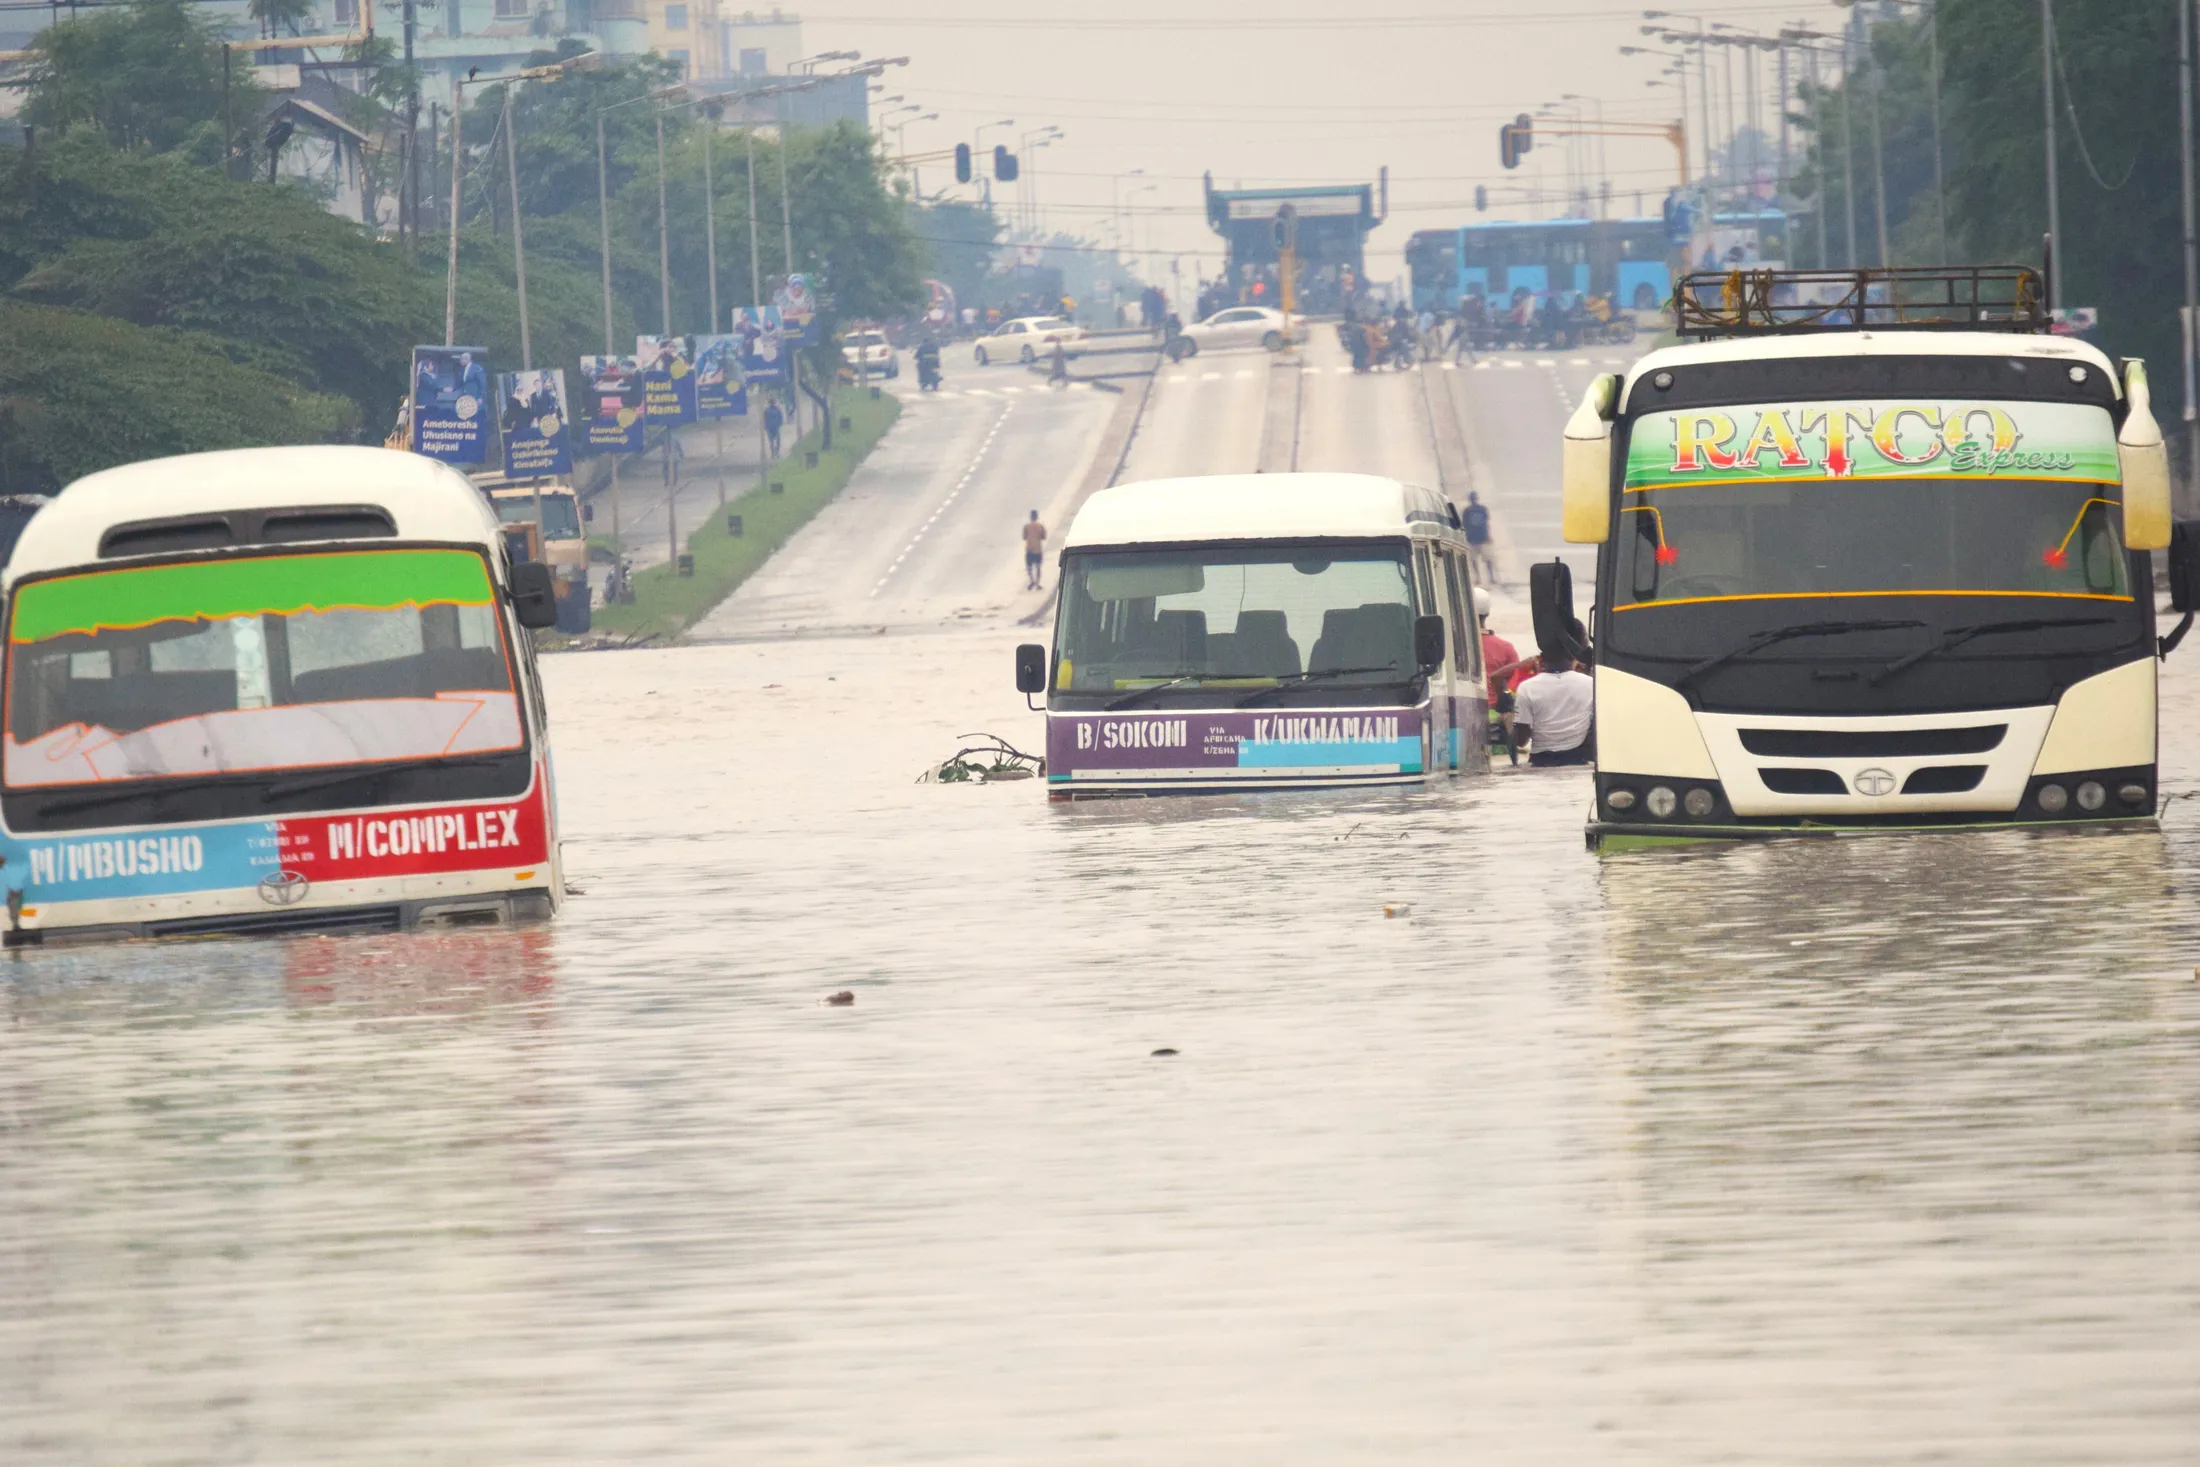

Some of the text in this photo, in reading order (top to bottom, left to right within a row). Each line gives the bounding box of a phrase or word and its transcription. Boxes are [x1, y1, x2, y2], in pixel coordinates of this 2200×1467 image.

[646, 381, 672, 391] Nani
[646, 394, 678, 403] Kama
[647, 405, 682, 415] Mama
[423, 420, 478, 429] Ameboresha
[423, 430, 464, 440] Uhusiano
[1669, 405, 2023, 477] RATCO
[423, 441, 459, 454] Majirani
[1949, 440, 2076, 476] Express
[1077, 719, 1187, 751] B/SOKONI
[1209, 726, 1225, 734] VIA
[1254, 714, 1398, 745] K/UKWAMANI
[327, 808, 520, 860] M/COMPLEX
[29, 835, 204, 885] M/MBUSHO
